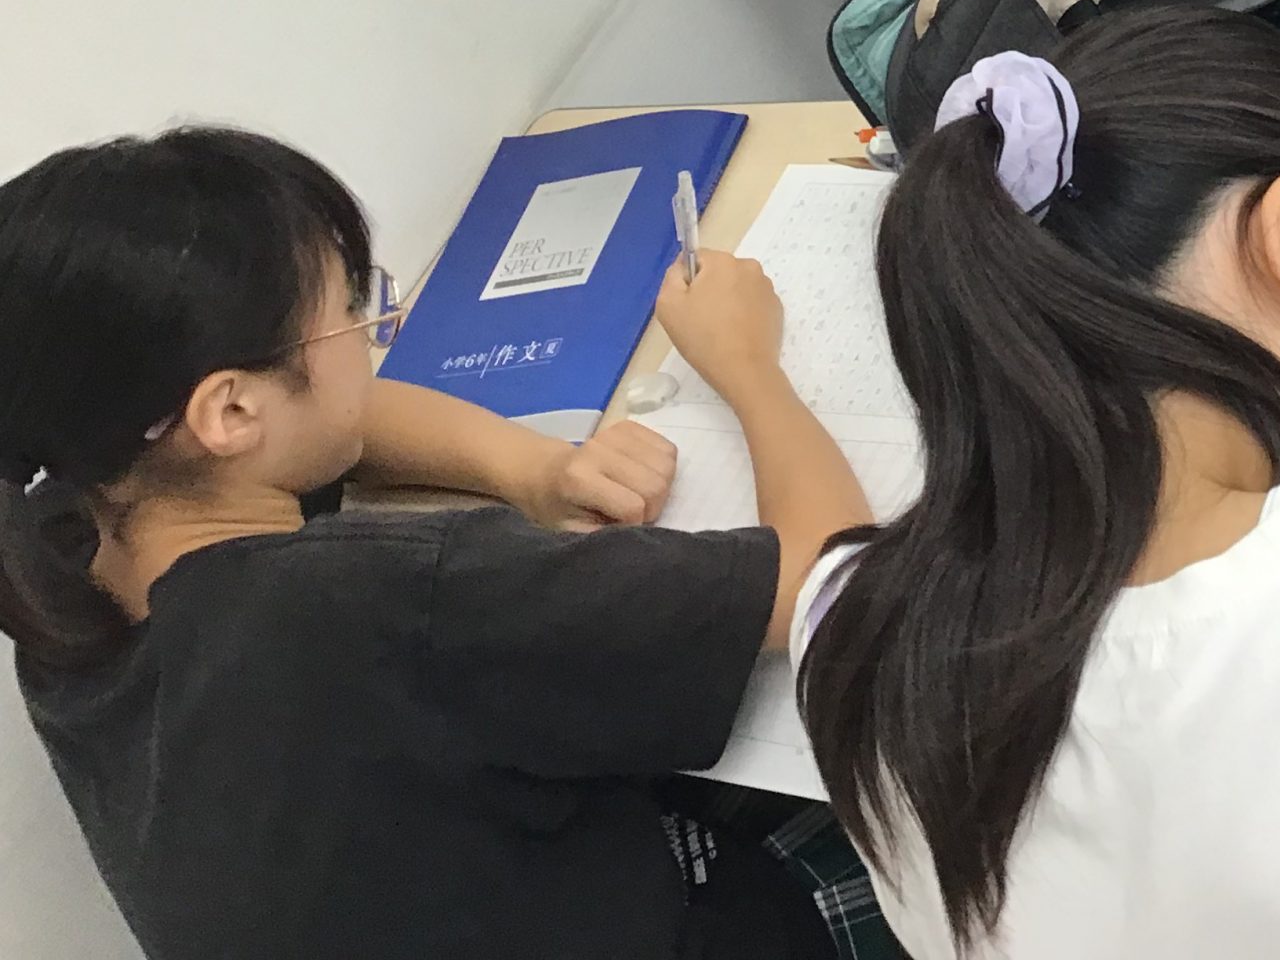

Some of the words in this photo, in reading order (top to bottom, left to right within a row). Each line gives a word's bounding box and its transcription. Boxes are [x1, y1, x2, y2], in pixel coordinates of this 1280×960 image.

[508, 238, 545, 258] PER
[500, 247, 592, 277] SPECTIVE
[494, 341, 541, 366] 作文
